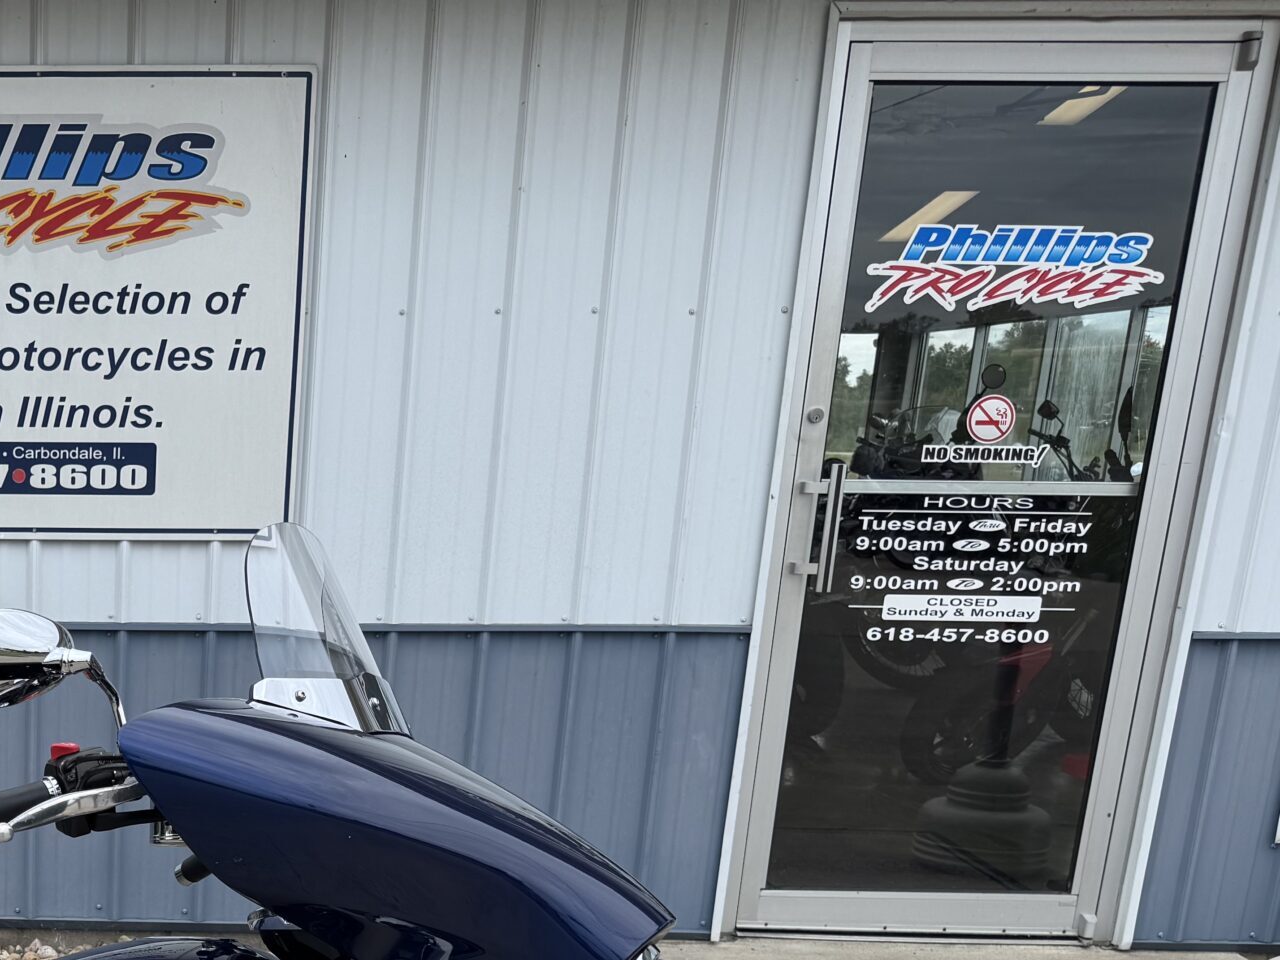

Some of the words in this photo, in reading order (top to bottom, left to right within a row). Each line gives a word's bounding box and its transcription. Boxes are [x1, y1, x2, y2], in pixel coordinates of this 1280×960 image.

[900, 224, 1152, 267] Phillips
[868, 264, 993, 312] PRO
[968, 265, 1164, 309] CYCLE
[5, 282, 192, 316] Selection
[204, 283, 251, 316] of
[228, 340, 267, 373] in
[15, 395, 165, 430] Illinois.
[11, 446, 108, 462] Carbondale,
[922, 446, 949, 462] NO
[951, 444, 1050, 468] SMOKING!
[923, 496, 1034, 509] HOURS
[858, 516, 963, 536] Tuesday
[1013, 518, 1093, 537] Friday
[855, 536, 945, 551] 9:00am
[996, 538, 1089, 556] 5:00pm
[912, 556, 1025, 575] Saturday
[849, 575, 939, 591] 9:00am
[989, 577, 1081, 595] 2:00pm
[926, 597, 998, 608] CLOSED
[886, 607, 949, 618] Sunday
[953, 608, 965, 617] &
[970, 608, 1036, 619] Monday
[865, 626, 1050, 645] 618-457-8600
